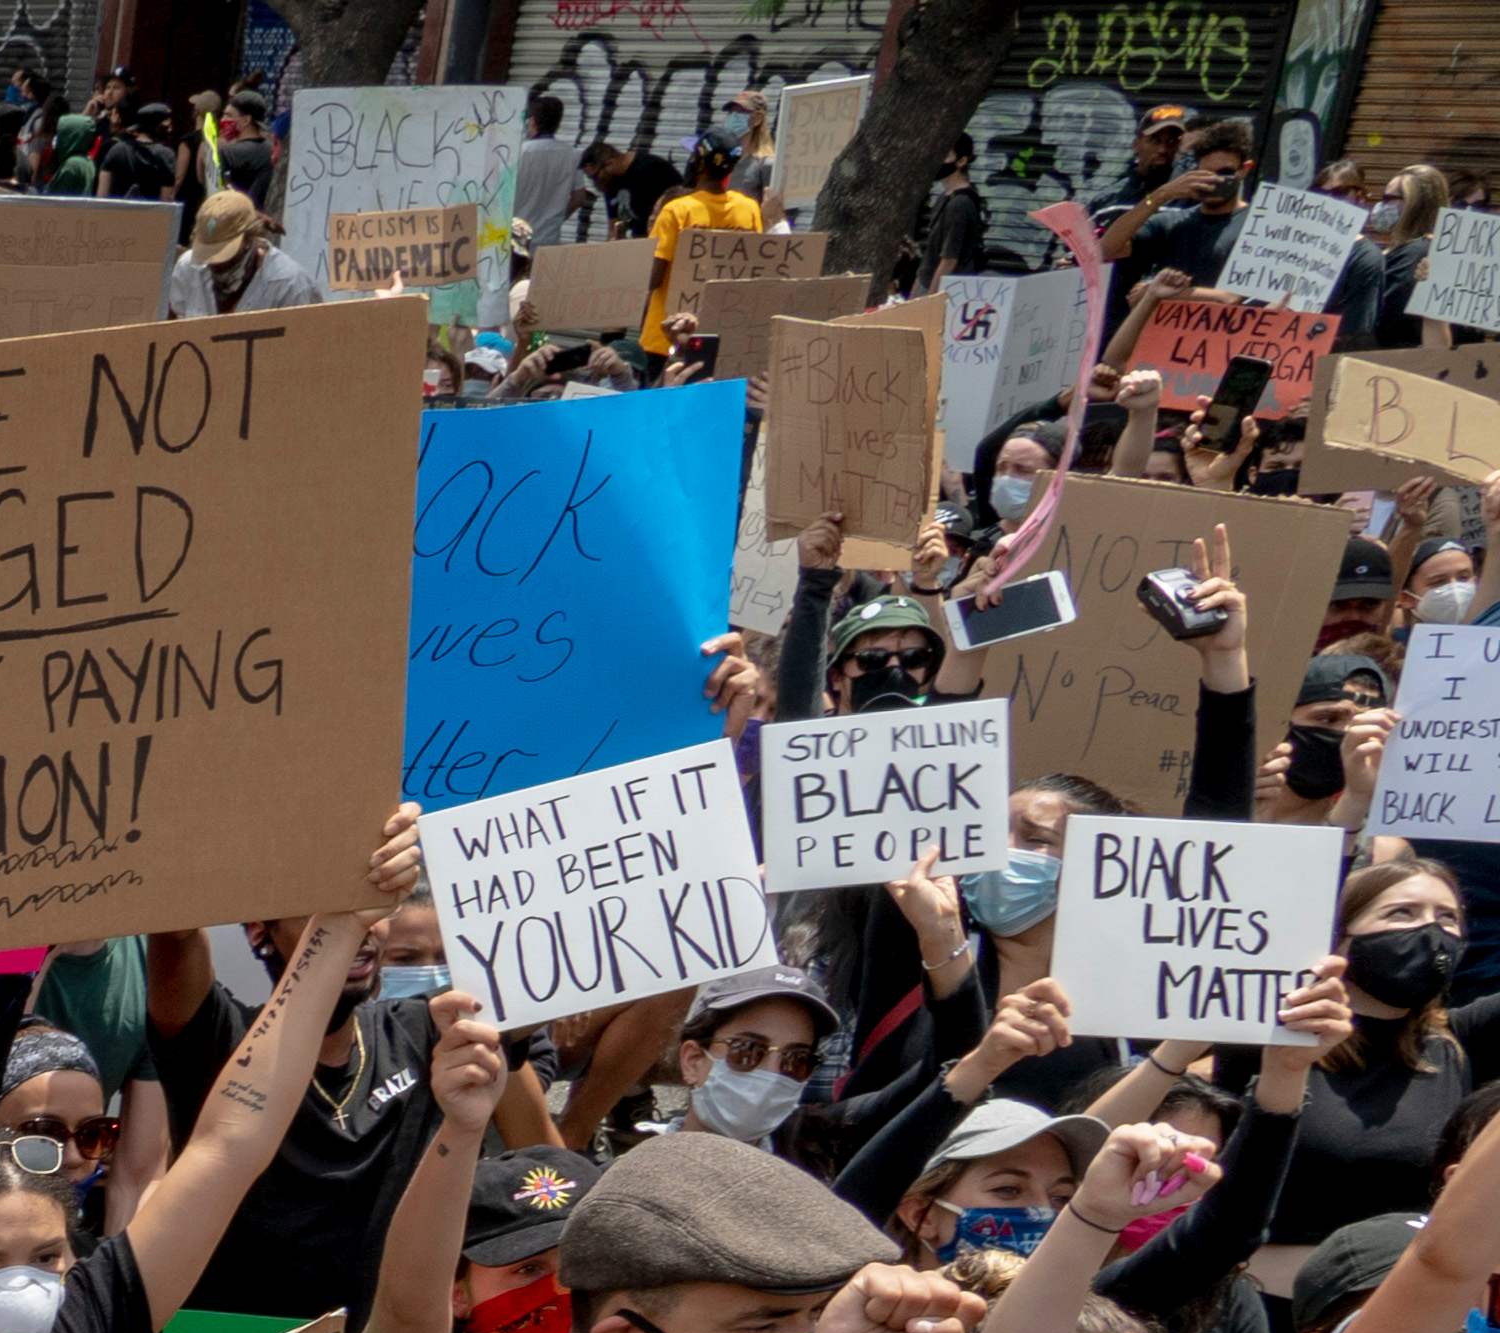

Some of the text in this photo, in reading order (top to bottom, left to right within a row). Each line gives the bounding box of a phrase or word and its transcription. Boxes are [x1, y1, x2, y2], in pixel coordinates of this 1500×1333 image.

[309, 101, 462, 178] BLACK
[1254, 185, 1276, 211] I
[335, 213, 464, 242] RACISM IS A
[688, 232, 805, 262] BLACK
[1244, 213, 1264, 237] I
[1437, 212, 1499, 258] BLACK
[332, 235, 472, 283] PANDEMIC
[1227, 263, 1256, 287] but
[1453, 259, 1499, 289] LIVES
[1153, 302, 1302, 342] VAYANSE A
[780, 337, 909, 406] #Black
[1168, 336, 1208, 369] LA
[82, 326, 287, 459] NOT
[820, 415, 898, 459] Lives
[42, 626, 288, 732] PAYING
[781, 716, 1000, 764] STOP KILLING
[1404, 753, 1473, 774] WILL
[451, 761, 718, 863] WHAT IF IT
[792, 761, 983, 825] BLACK
[1381, 790, 1458, 826] BLACK
[796, 823, 987, 870] PEOPLE
[451, 828, 681, 920] HAD BEEN
[456, 875, 770, 1023] YOUR KID
[1143, 902, 1269, 955] LIVES
